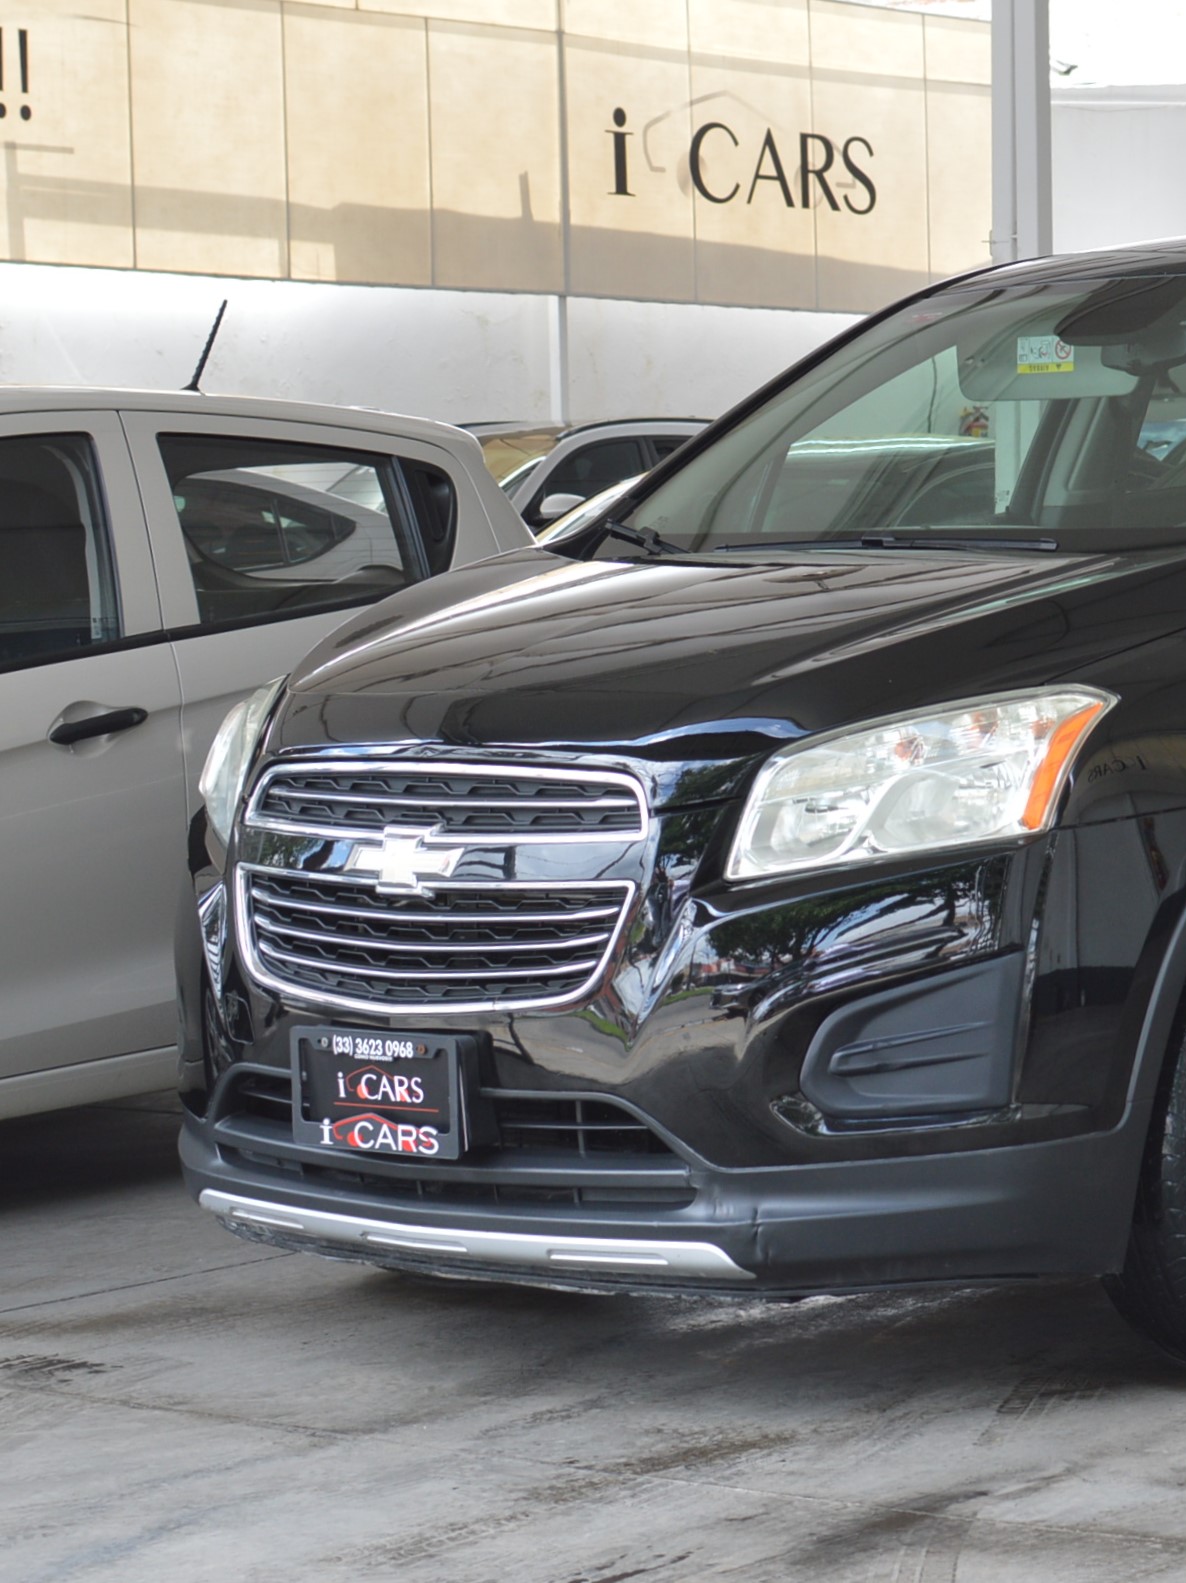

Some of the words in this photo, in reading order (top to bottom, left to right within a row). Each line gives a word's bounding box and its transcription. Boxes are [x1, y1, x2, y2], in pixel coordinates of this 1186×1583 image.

[689, 121, 877, 216] CARS
[332, 1034, 354, 1056] (33)
[355, 1037, 383, 1056] 3623
[385, 1039, 414, 1059] 0968
[337, 1071, 347, 1098] i
[360, 1073, 424, 1104] CARS
[319, 1117, 334, 1145] i
[353, 1121, 439, 1155] CARS
